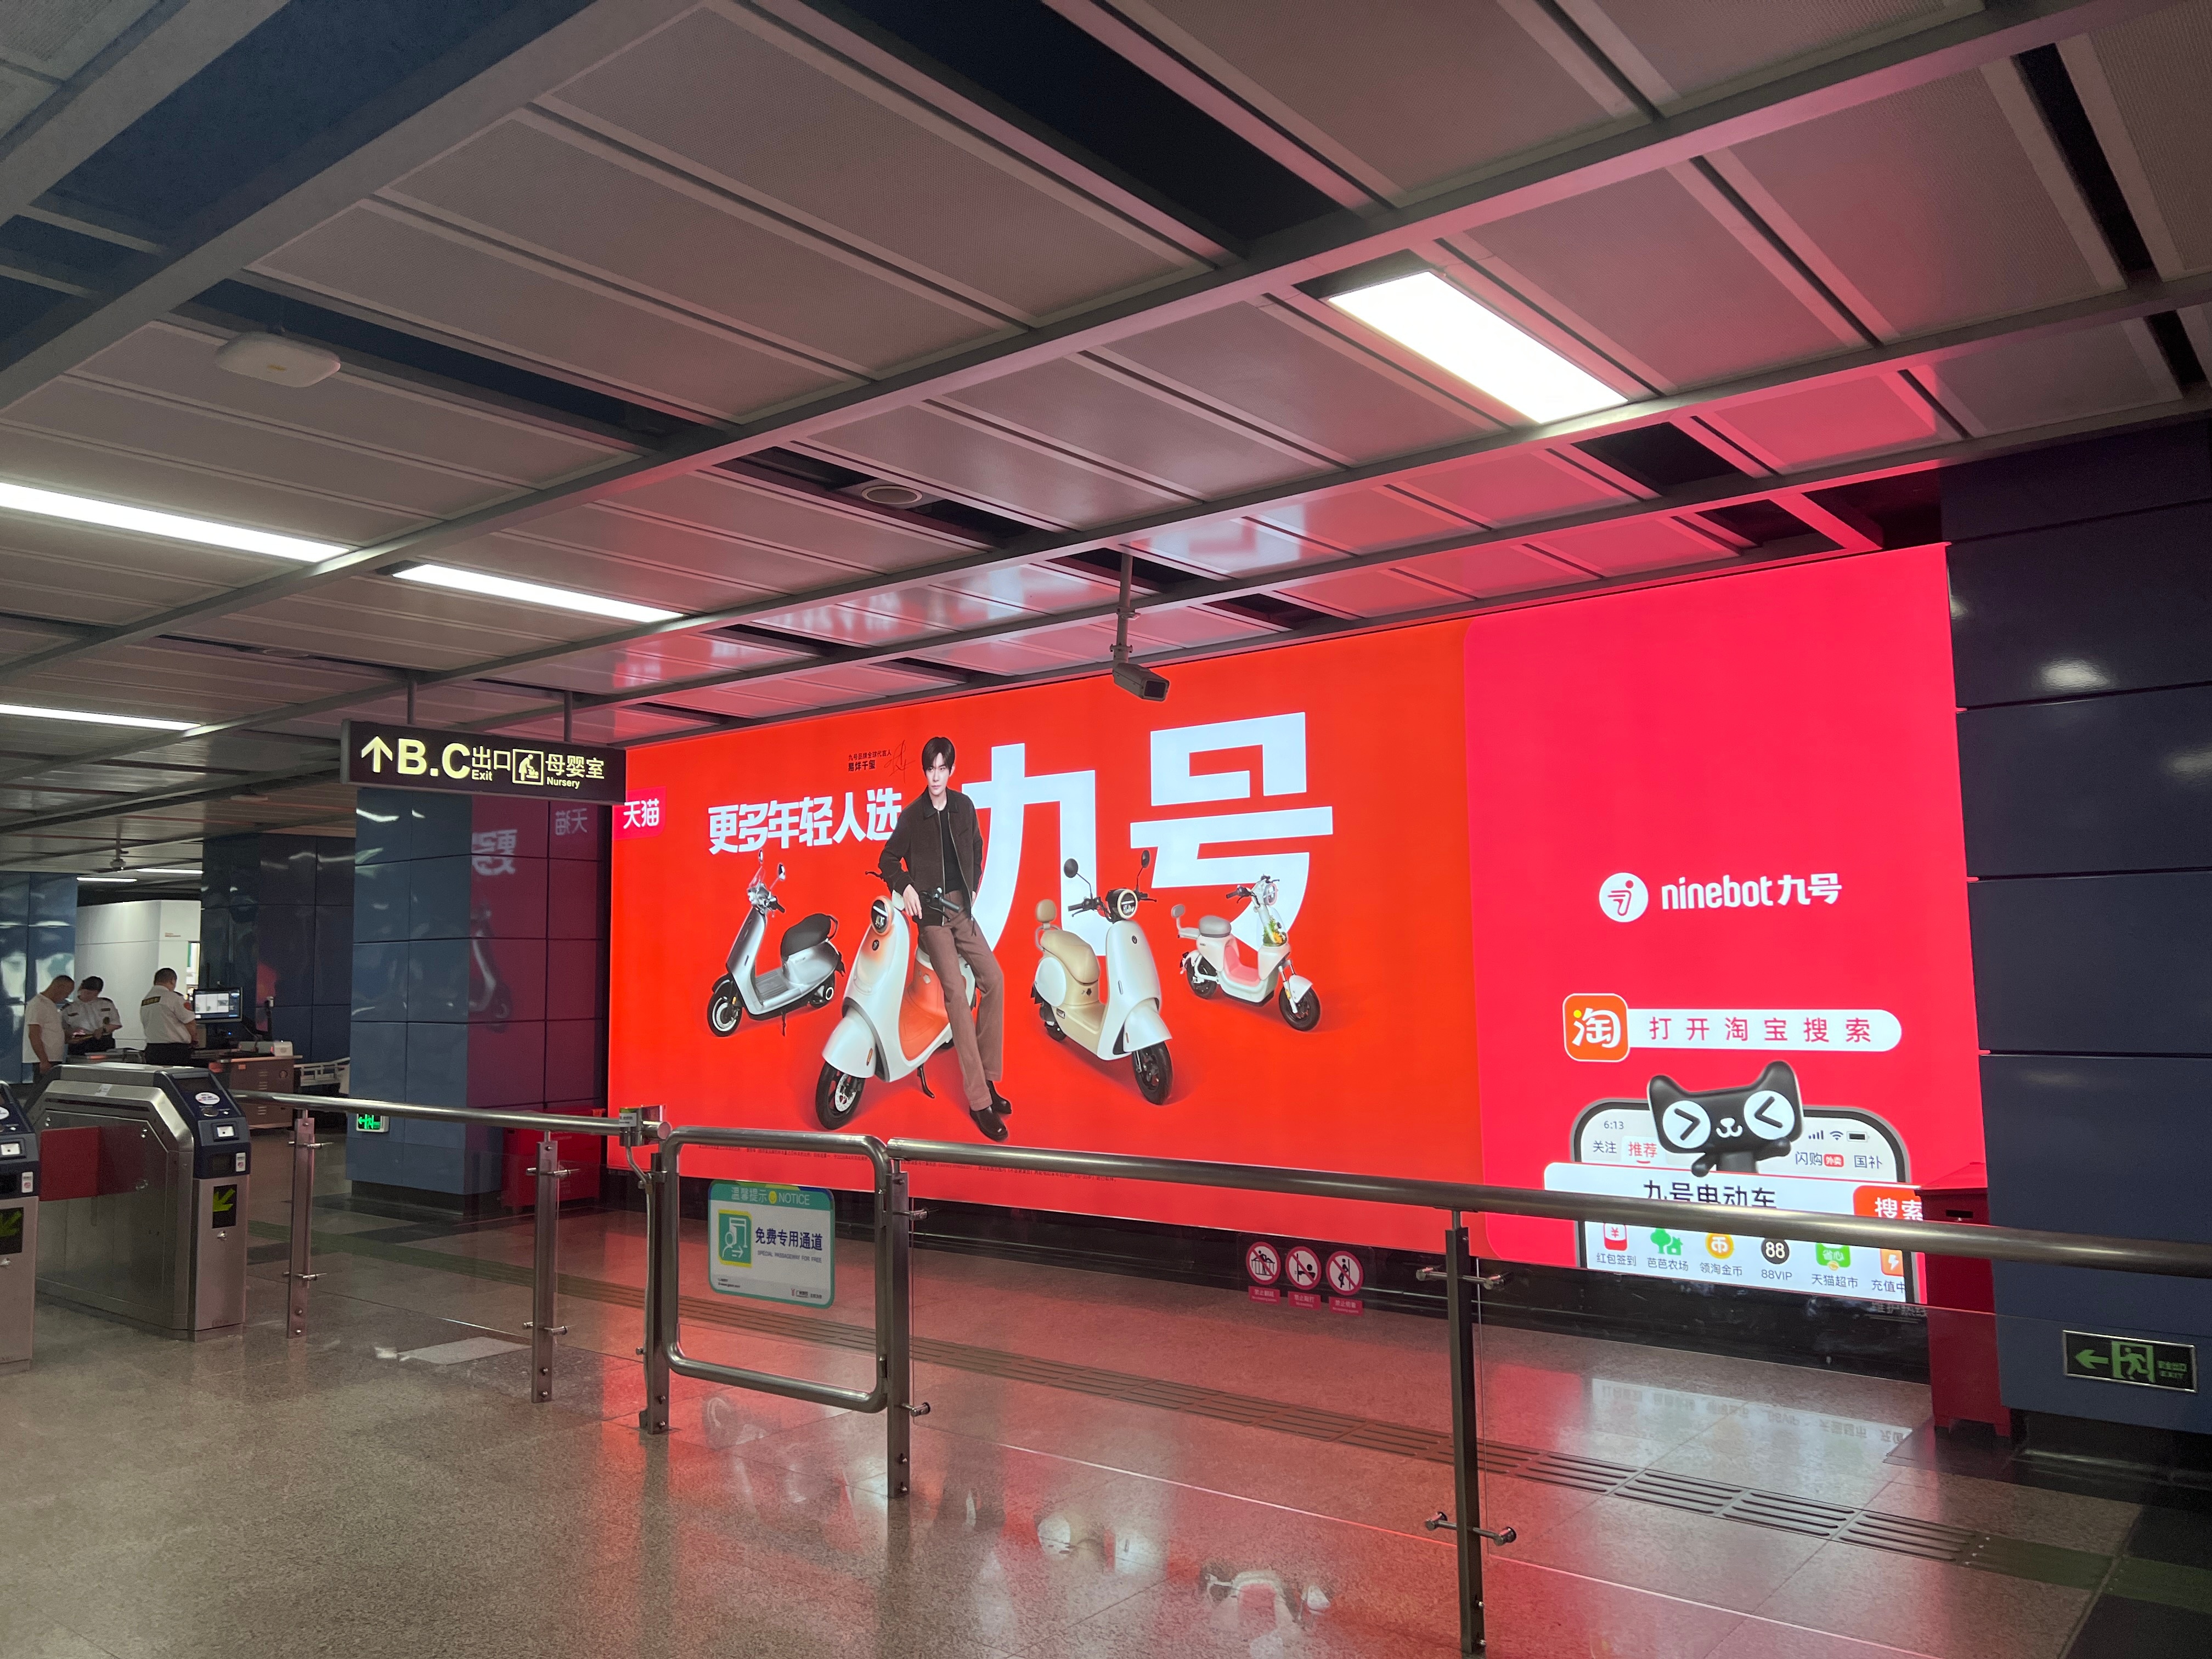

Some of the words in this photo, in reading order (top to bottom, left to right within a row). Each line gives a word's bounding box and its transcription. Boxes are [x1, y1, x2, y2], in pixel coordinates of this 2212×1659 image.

[472, 746, 511, 771] 出口
[545, 753, 605, 780] 母婴室
[471, 769, 493, 782] Exit
[546, 776, 580, 789] Nursery
[623, 798, 659, 830] 天猫
[708, 787, 902, 855] 更多年轻人选
[961, 712, 1333, 956] 九号
[1661, 874, 1774, 910] ninebot
[1777, 873, 1842, 906] 九号
[1571, 1007, 1622, 1049] 淘
[1649, 1015, 1872, 1044] 打开淘宝搜索
[1604, 1120, 1624, 1130] 6:13
[1593, 1140, 1617, 1154] 关注
[1628, 1141, 1657, 1158] 推荐
[1795, 1151, 1822, 1166] 闪购
[1825, 1155, 1843, 1166] 外卖
[1854, 1155, 1882, 1169] 国补
[731, 1187, 768, 1203] 温馨提示
[778, 1192, 811, 1205] NOTICE
[1643, 1180, 1778, 1209] 九号电动车
[1874, 1197, 1923, 1221] 搜索
[755, 1226, 823, 1251] 免费专用通道
[1765, 1241, 1786, 1259] 88
[1822, 1249, 1844, 1262] 省心
[1596, 1252, 1637, 1266] 红包签到
[1647, 1257, 1689, 1272] 芭芭农场
[1700, 1262, 1743, 1277] 领淘金币
[1760, 1269, 1792, 1281] 88VIP
[1811, 1273, 1858, 1289] 天猫超市
